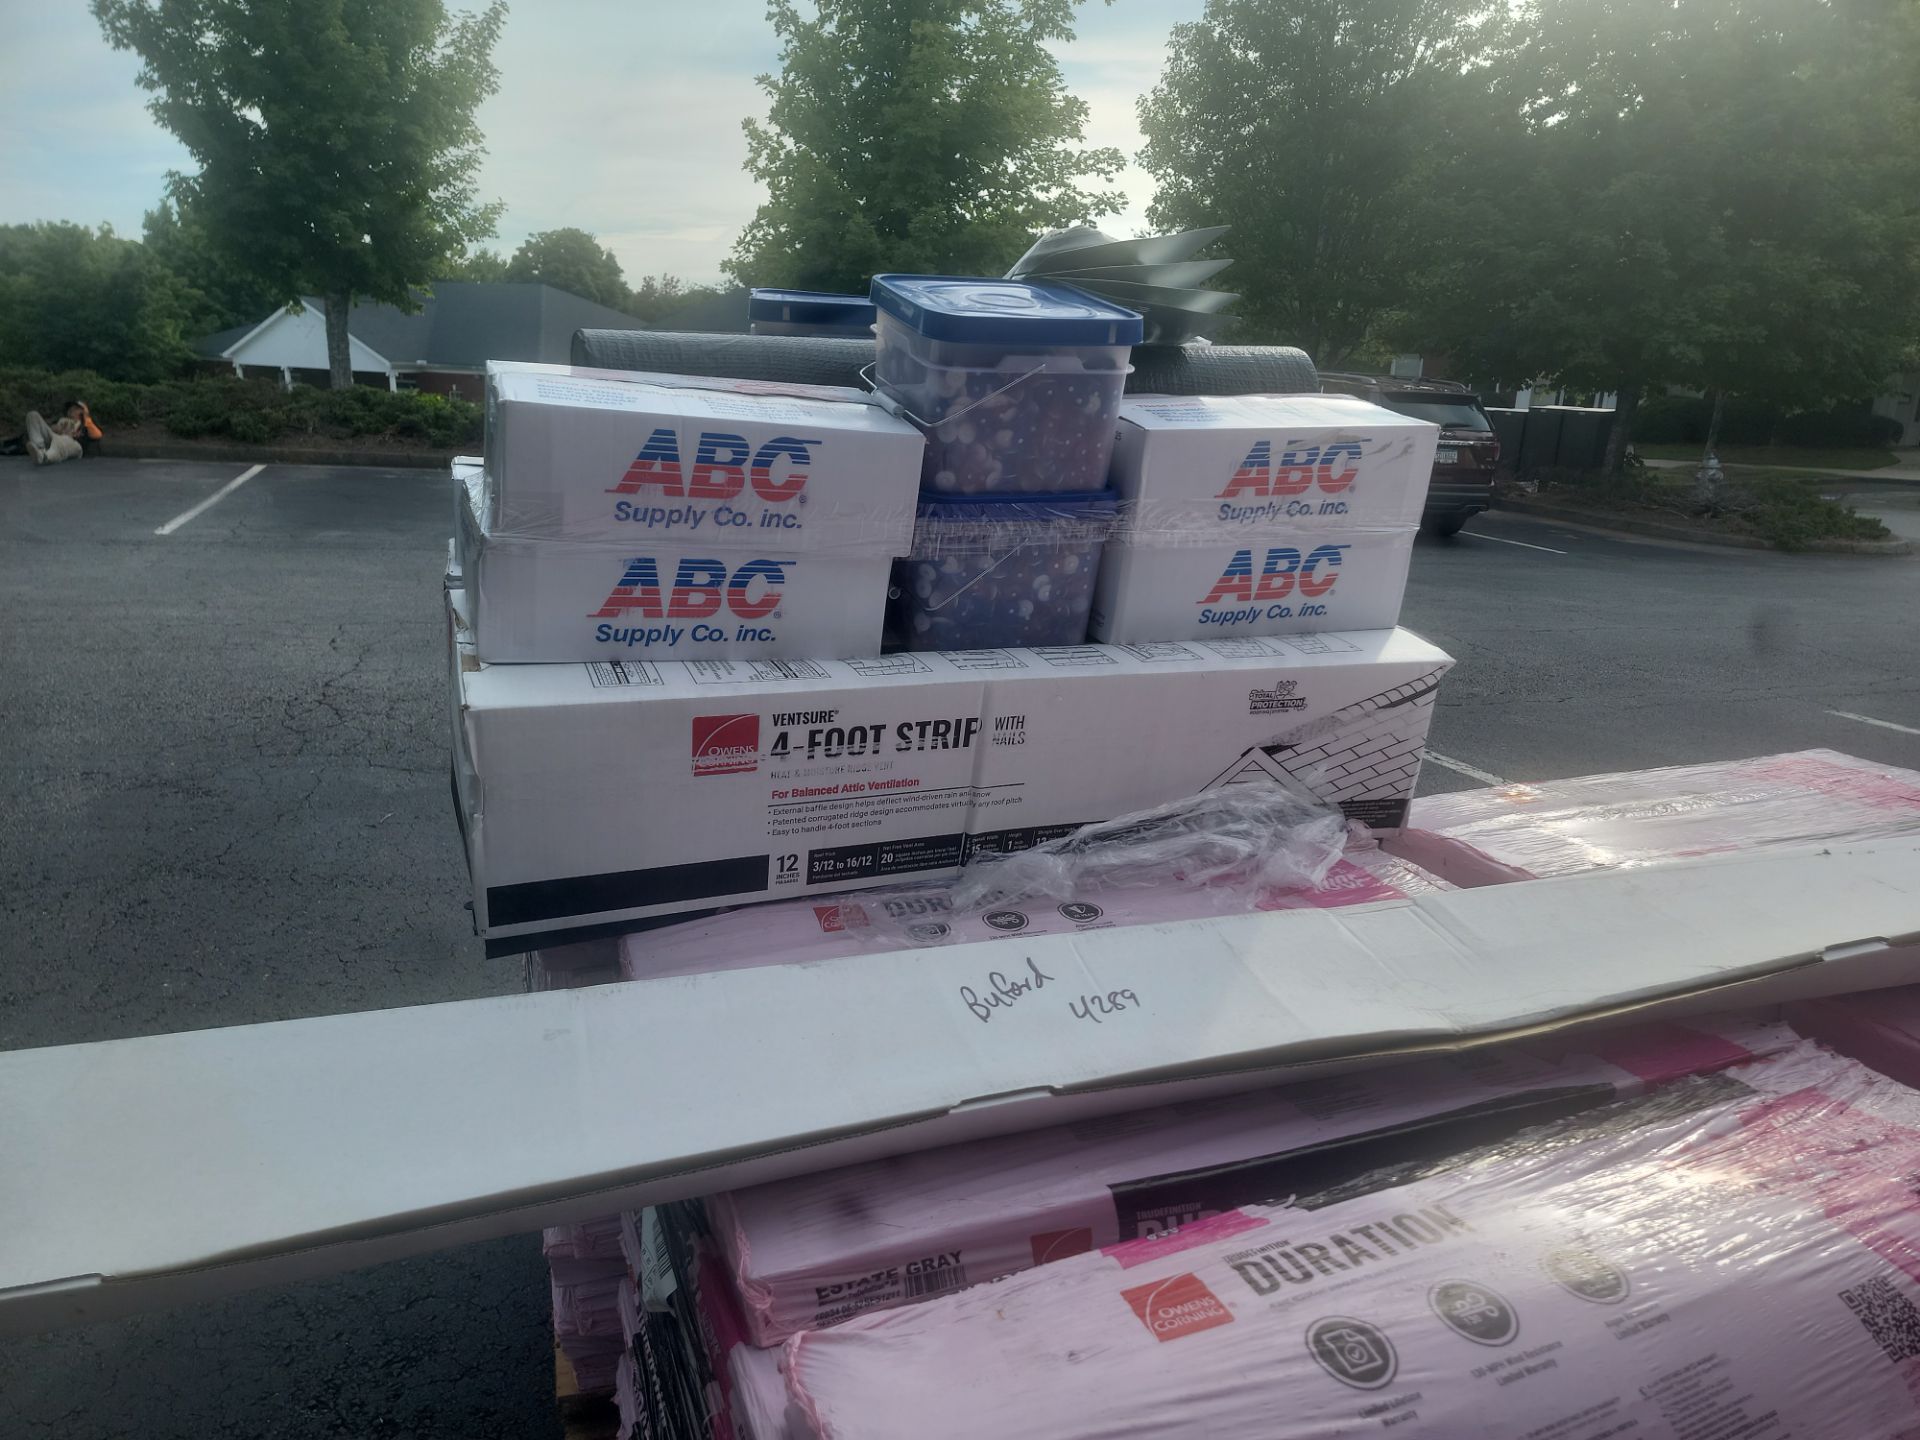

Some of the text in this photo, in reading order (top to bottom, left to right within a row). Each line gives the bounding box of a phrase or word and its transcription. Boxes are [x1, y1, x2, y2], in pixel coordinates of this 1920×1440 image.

[604, 428, 822, 502] ABC
[1214, 438, 1372, 498] ABC
[614, 500, 802, 530] Supply Co. inc.
[1217, 500, 1348, 524] Supply Co. inc.
[1196, 544, 1352, 604] ABC
[586, 557, 796, 619] ABC
[1198, 602, 1327, 626] Supply Co. inc.
[595, 623, 776, 647] Supply Co. inc.
[1250, 699, 1303, 709] PROTECTION
[994, 715, 1026, 731] WITH
[770, 717, 983, 760] 4-FOOT STRIP
[991, 731, 1026, 746] NAILS
[708, 745, 755, 758] OWENS
[771, 779, 920, 800] For Balanced Attic Ventilation
[772, 816, 807, 826] Patented
[807, 811, 849, 822] corrugated
[850, 809, 869, 818] ridge
[870, 807, 894, 817] design
[895, 802, 950, 814] accommodates
[1005, 797, 1023, 805] pitch
[773, 806, 804, 816] External
[805, 803, 828, 813] baffle
[829, 800, 854, 811] design
[855, 798, 875, 808] helps
[876, 796, 901, 806] deflect
[903, 793, 944, 803] wind-driven
[771, 819, 882, 837] Easy to handle 4-foot sections
[776, 853, 799, 873] 12
[813, 860, 834, 872] 3/12
[836, 861, 844, 869] to
[846, 855, 873, 868] 16/12
[880, 853, 894, 864] 20
[775, 872, 800, 880] INCHES
[1069, 989, 1141, 1023] 4289
[1136, 1202, 1201, 1220] TRUDEFINITION
[1222, 1238, 1292, 1264] TRUDEFINITION
[1230, 1202, 1476, 1296] DURATION
[815, 1267, 898, 1300] ESTATE
[905, 1250, 962, 1276] GRAY
[1154, 1305, 1224, 1332] CORNING
[1159, 1295, 1215, 1319] OWENS
